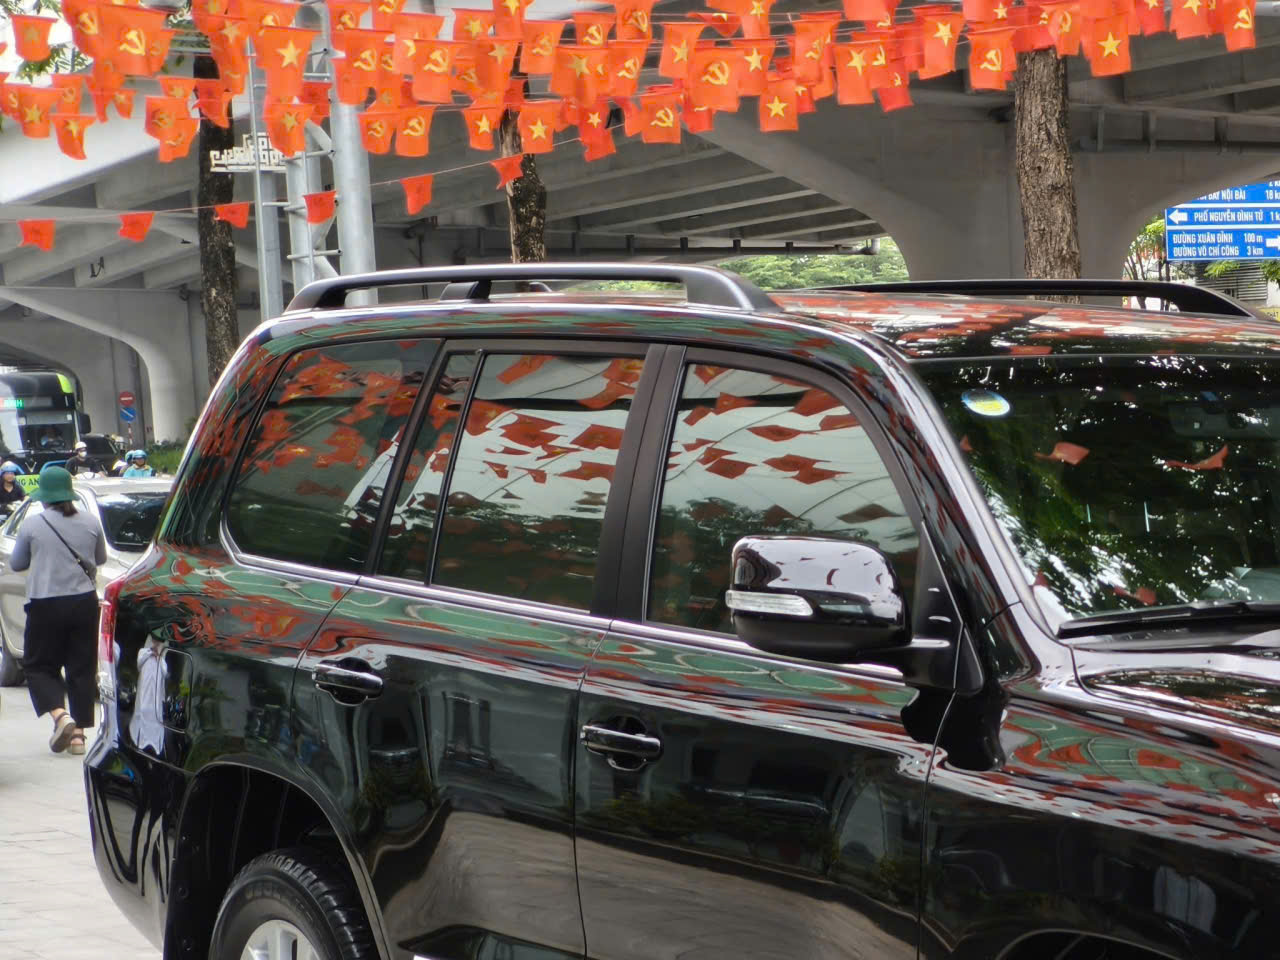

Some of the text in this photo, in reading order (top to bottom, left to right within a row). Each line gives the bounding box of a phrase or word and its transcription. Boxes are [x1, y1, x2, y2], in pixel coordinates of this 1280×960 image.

[1172, 231, 1196, 244] ĐƯỜNG
[1244, 232, 1255, 243] 100
[1256, 235, 1263, 243] m
[1173, 245, 1197, 257] ĐƯỜNG
[1247, 246, 1251, 256] 3
[1252, 246, 1264, 256] km
